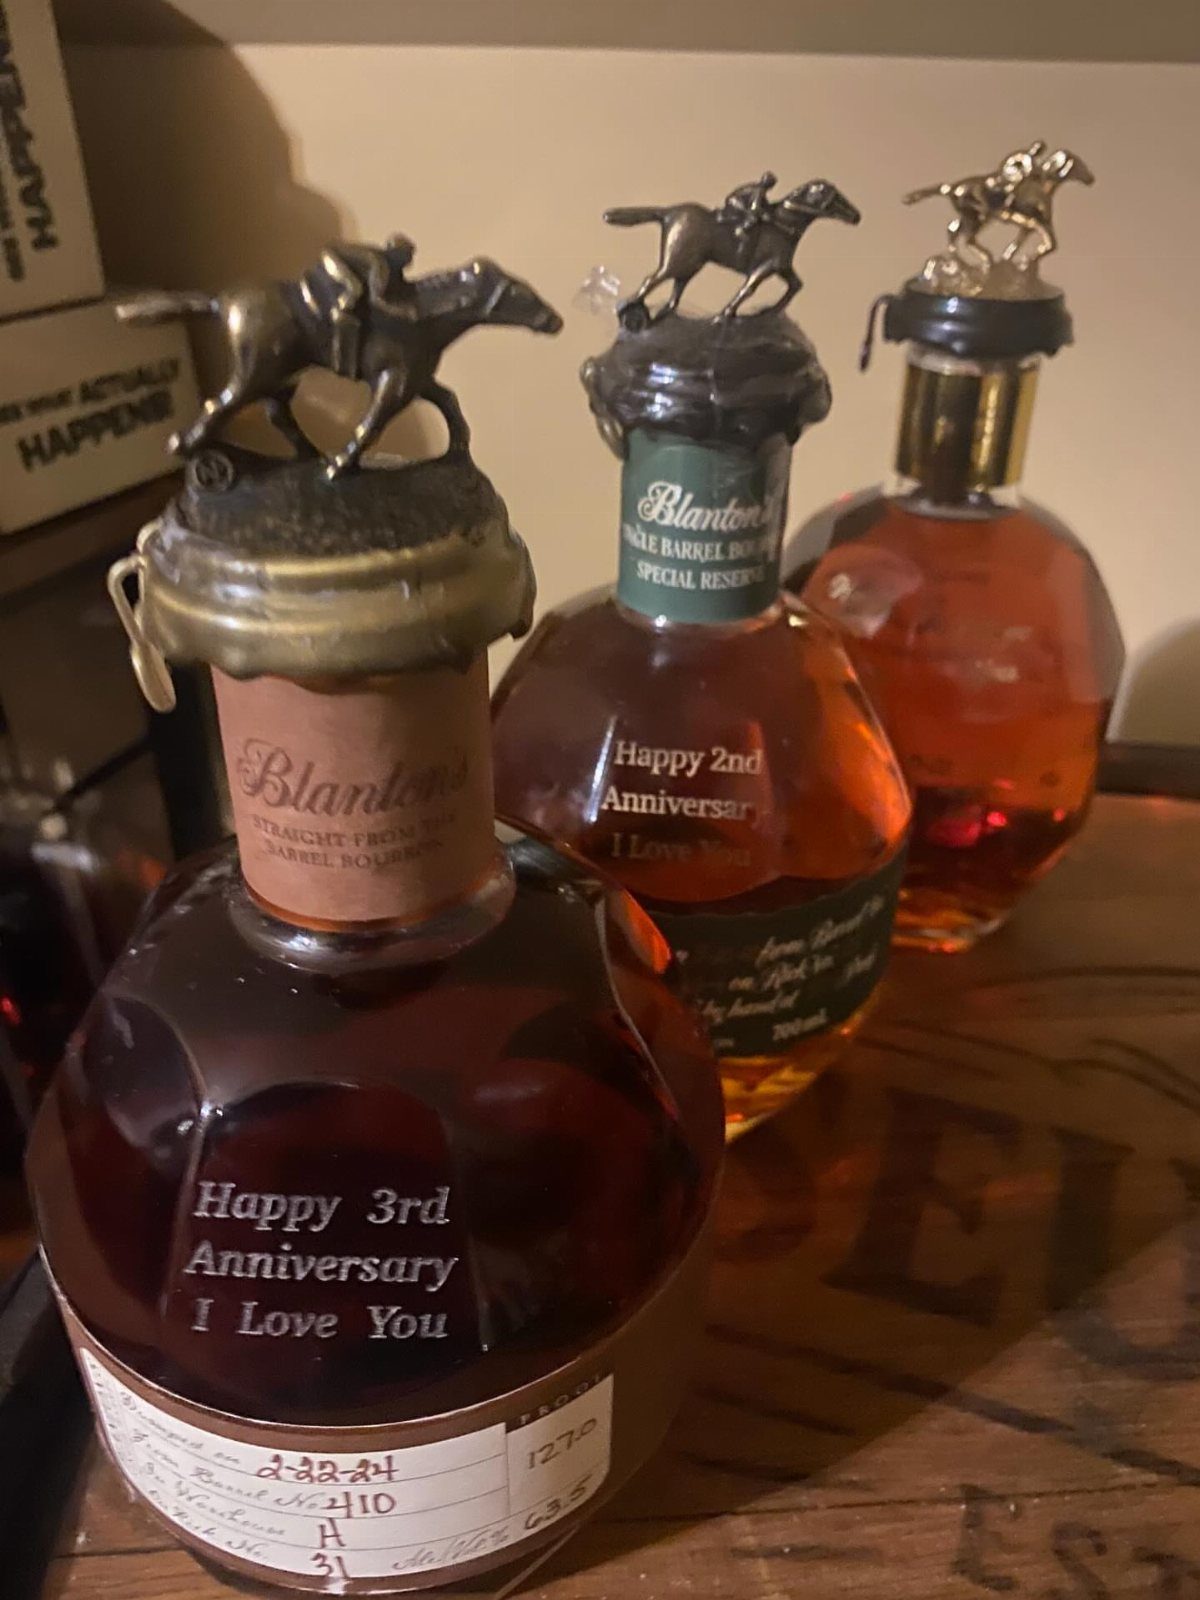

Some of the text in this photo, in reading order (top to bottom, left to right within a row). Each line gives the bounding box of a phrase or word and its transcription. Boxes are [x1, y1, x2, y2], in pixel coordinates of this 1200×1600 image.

[661, 535, 724, 563] BARREL
[636, 560, 696, 590] SPECIAL
[613, 739, 764, 777] Happy 2nd
[252, 813, 348, 849] STRAIGHT
[192, 1180, 450, 1233] Happy 3rd
[183, 1239, 460, 1293] Anniversary
[191, 1298, 449, 1340] I Love You
[256, 1453, 400, 1483] 2-22-24
[320, 1490, 396, 1519] 410
[318, 1517, 346, 1549] H
[310, 1552, 350, 1579] 31
